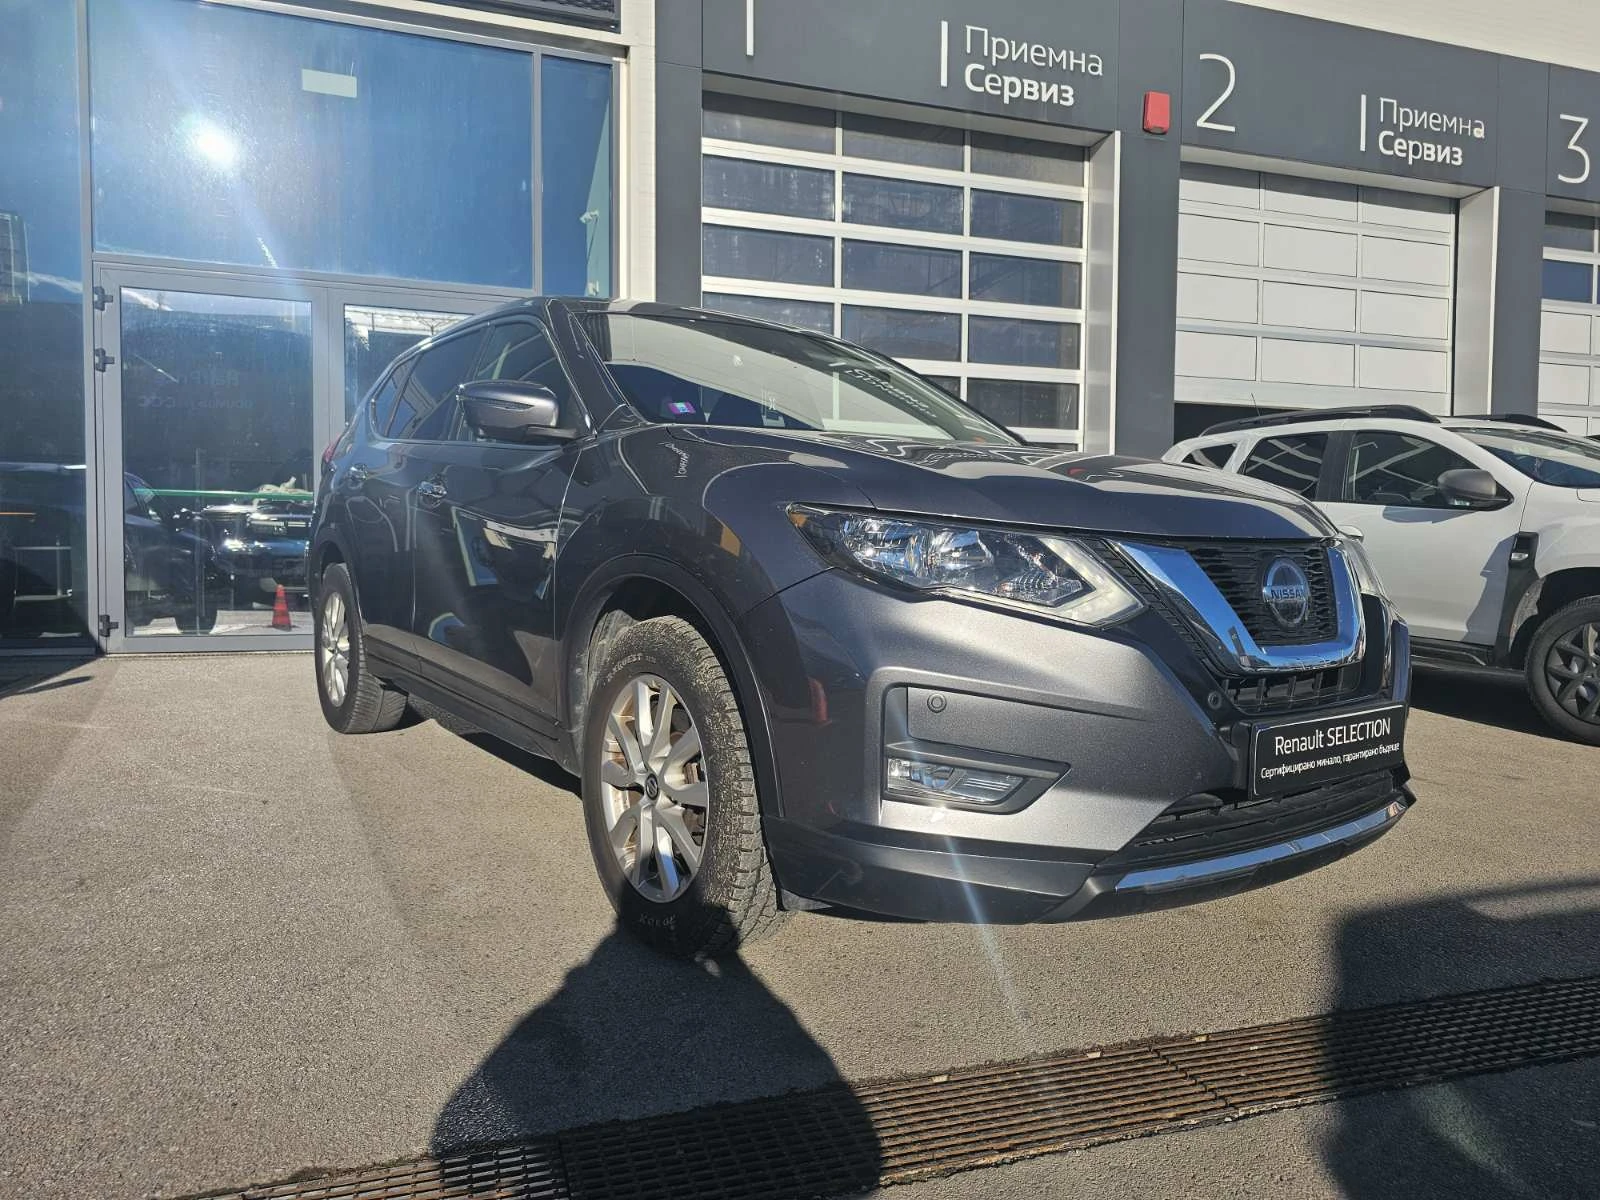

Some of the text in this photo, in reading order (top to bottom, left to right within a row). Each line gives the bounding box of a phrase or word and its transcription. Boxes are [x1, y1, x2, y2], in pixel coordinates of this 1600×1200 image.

[964, 24, 1104, 77] Приемна
[964, 62, 1075, 107] Сервиз
[1196, 53, 1236, 133] 2
[1379, 96, 1485, 139] Приемна
[1378, 130, 1463, 166] Сервиз
[1557, 113, 1591, 184] 3
[1275, 717, 1391, 756] Renault SELECTION
[1260, 758, 1316, 779] Сертифицирано
[1316, 755, 1343, 768] минало,
[1342, 747, 1379, 763] гарантирано
